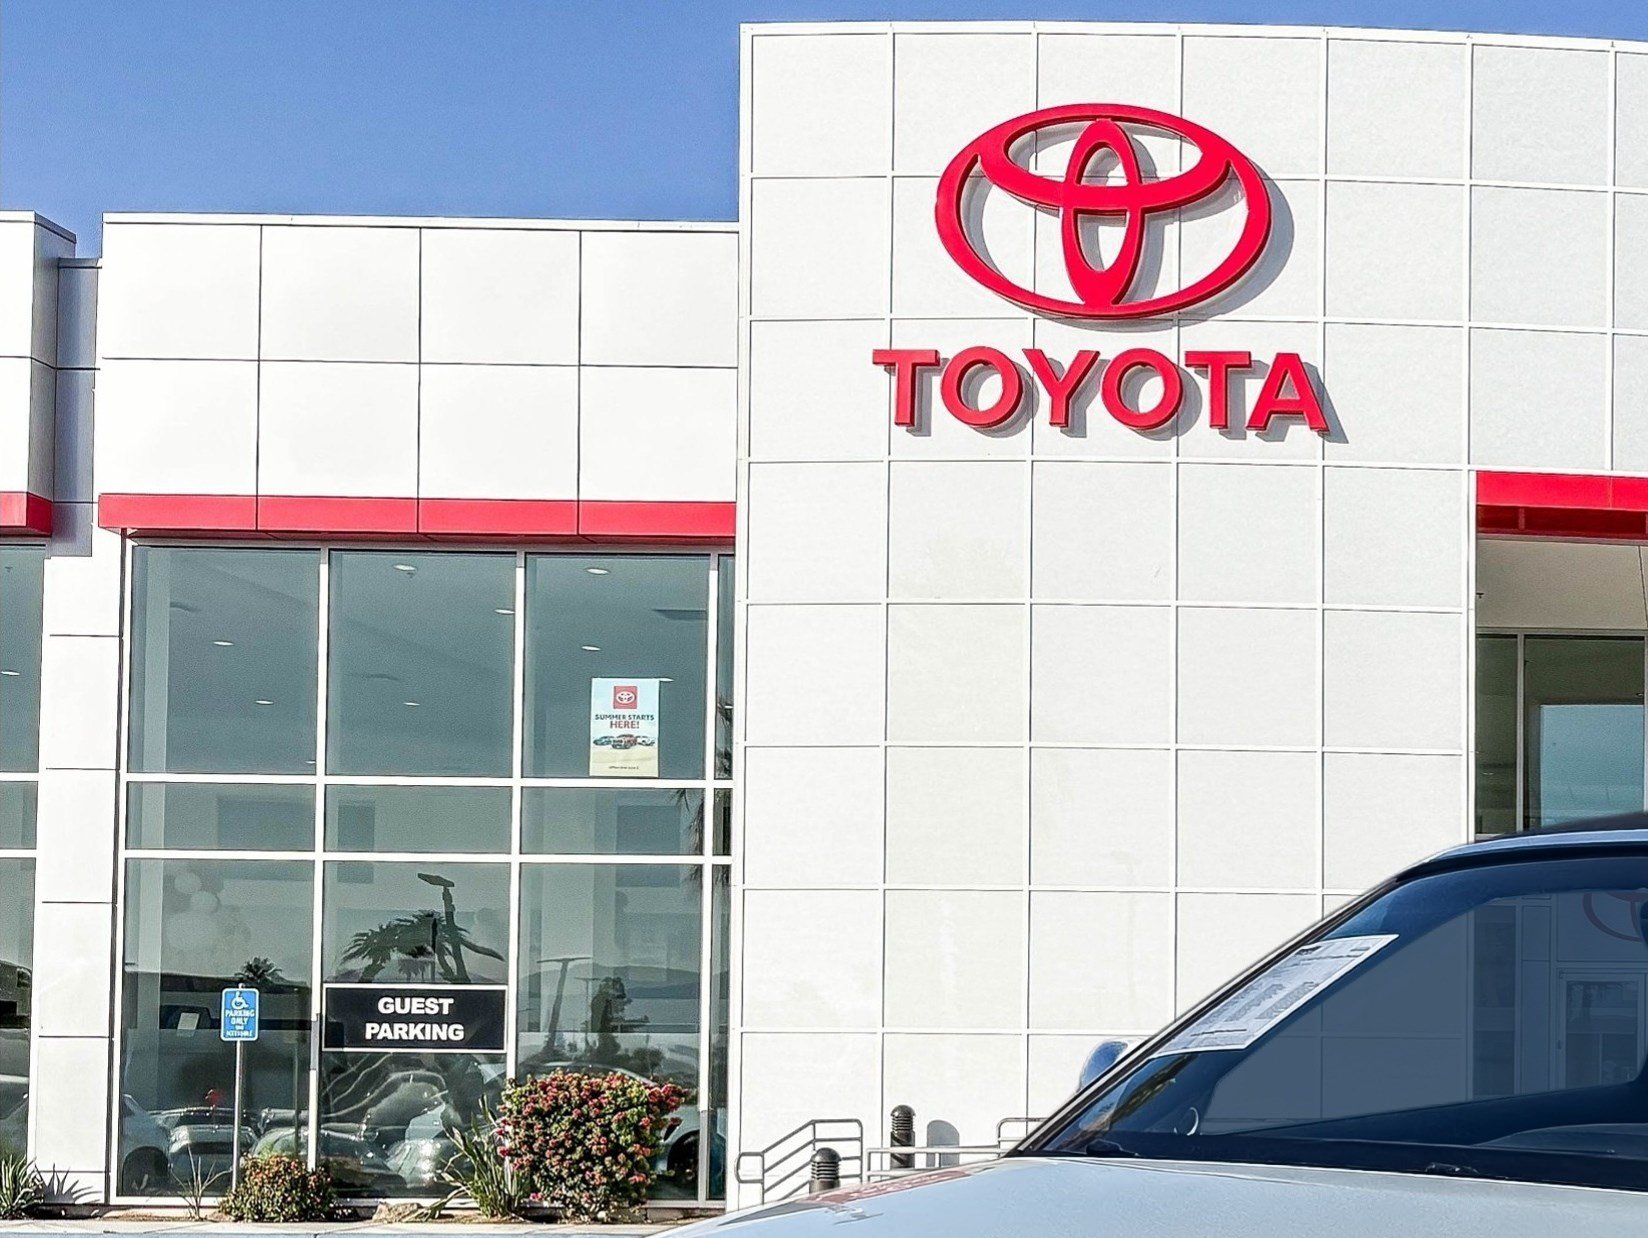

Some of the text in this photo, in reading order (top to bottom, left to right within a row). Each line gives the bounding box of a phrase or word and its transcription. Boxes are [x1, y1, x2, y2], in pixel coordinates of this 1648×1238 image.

[873, 346, 1329, 432] TOYOTA
[609, 720, 640, 729] HERE!
[377, 996, 455, 1015] GUEST
[364, 1022, 465, 1041] PARKING
